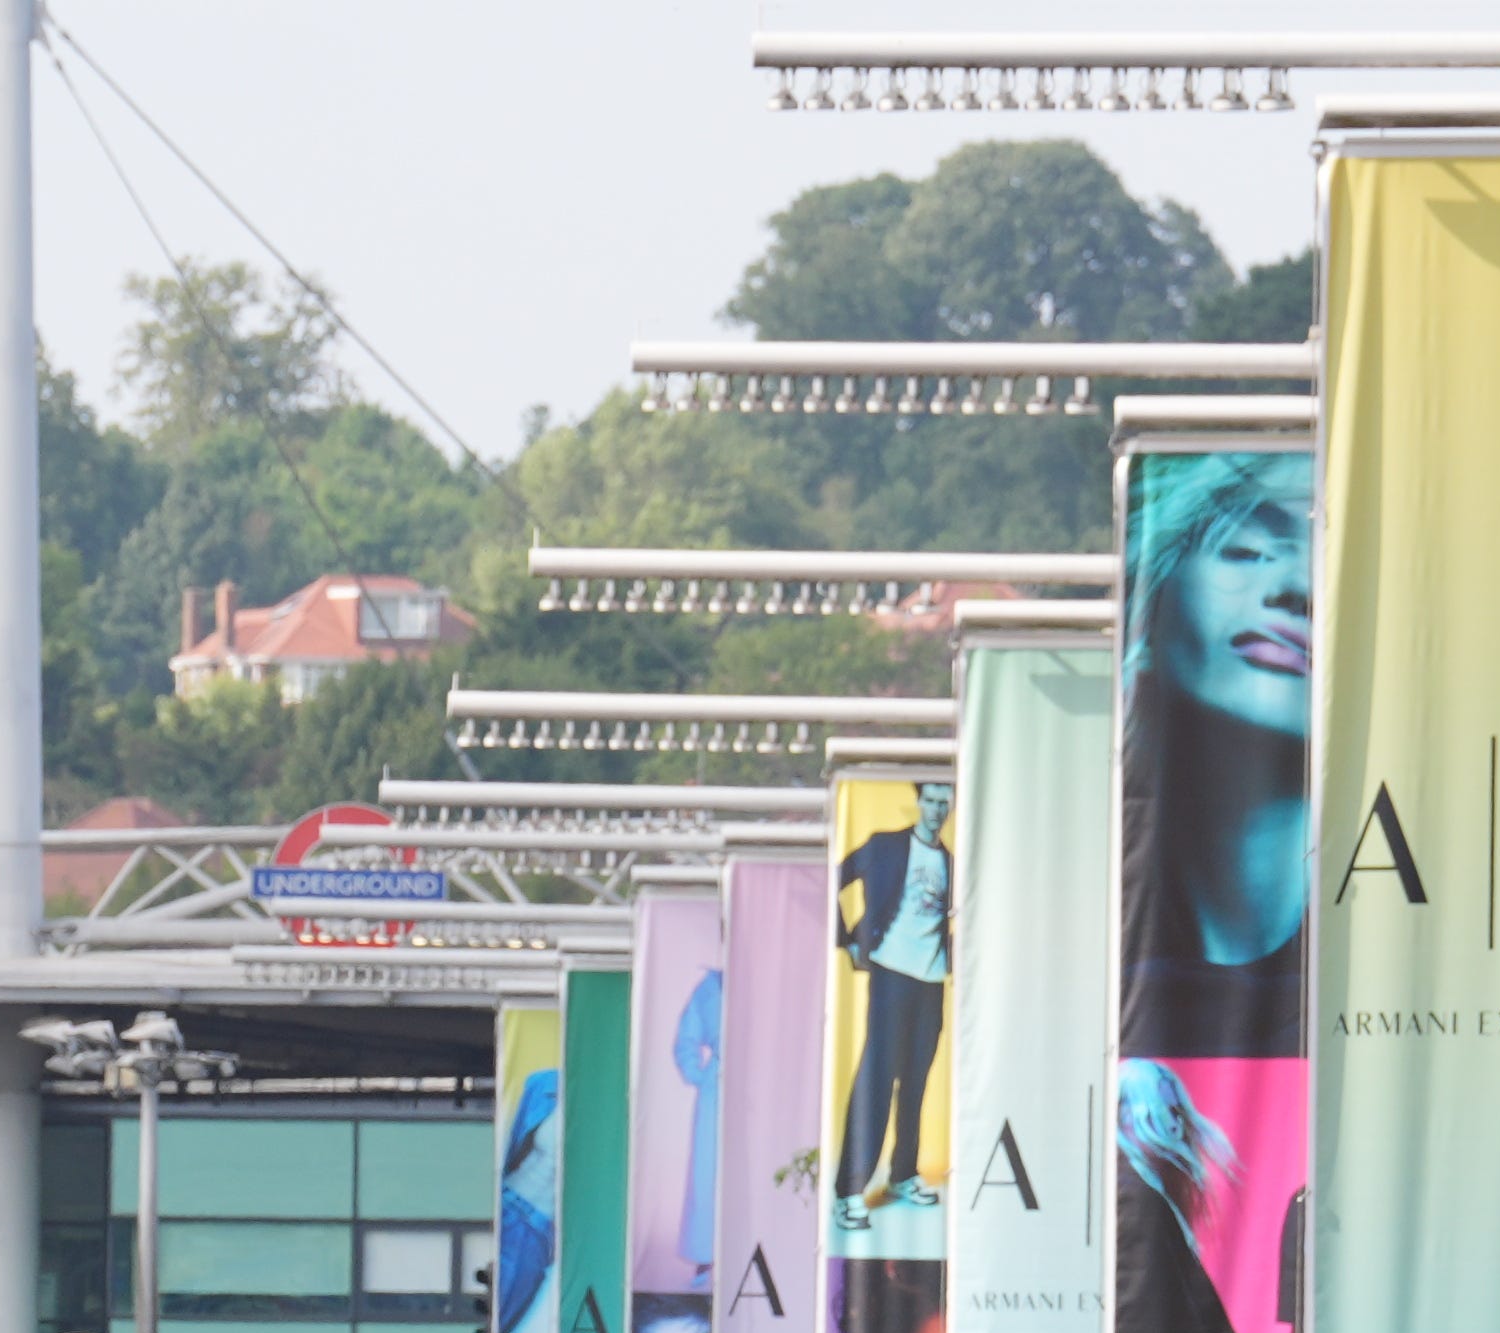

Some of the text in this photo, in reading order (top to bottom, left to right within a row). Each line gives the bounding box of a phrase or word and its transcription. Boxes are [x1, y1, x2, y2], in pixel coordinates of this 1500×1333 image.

[256, 869, 442, 897] UNDERGROUND
[1333, 1010, 1458, 1035] ARMANI
[969, 1291, 1063, 1311] ARMANI
